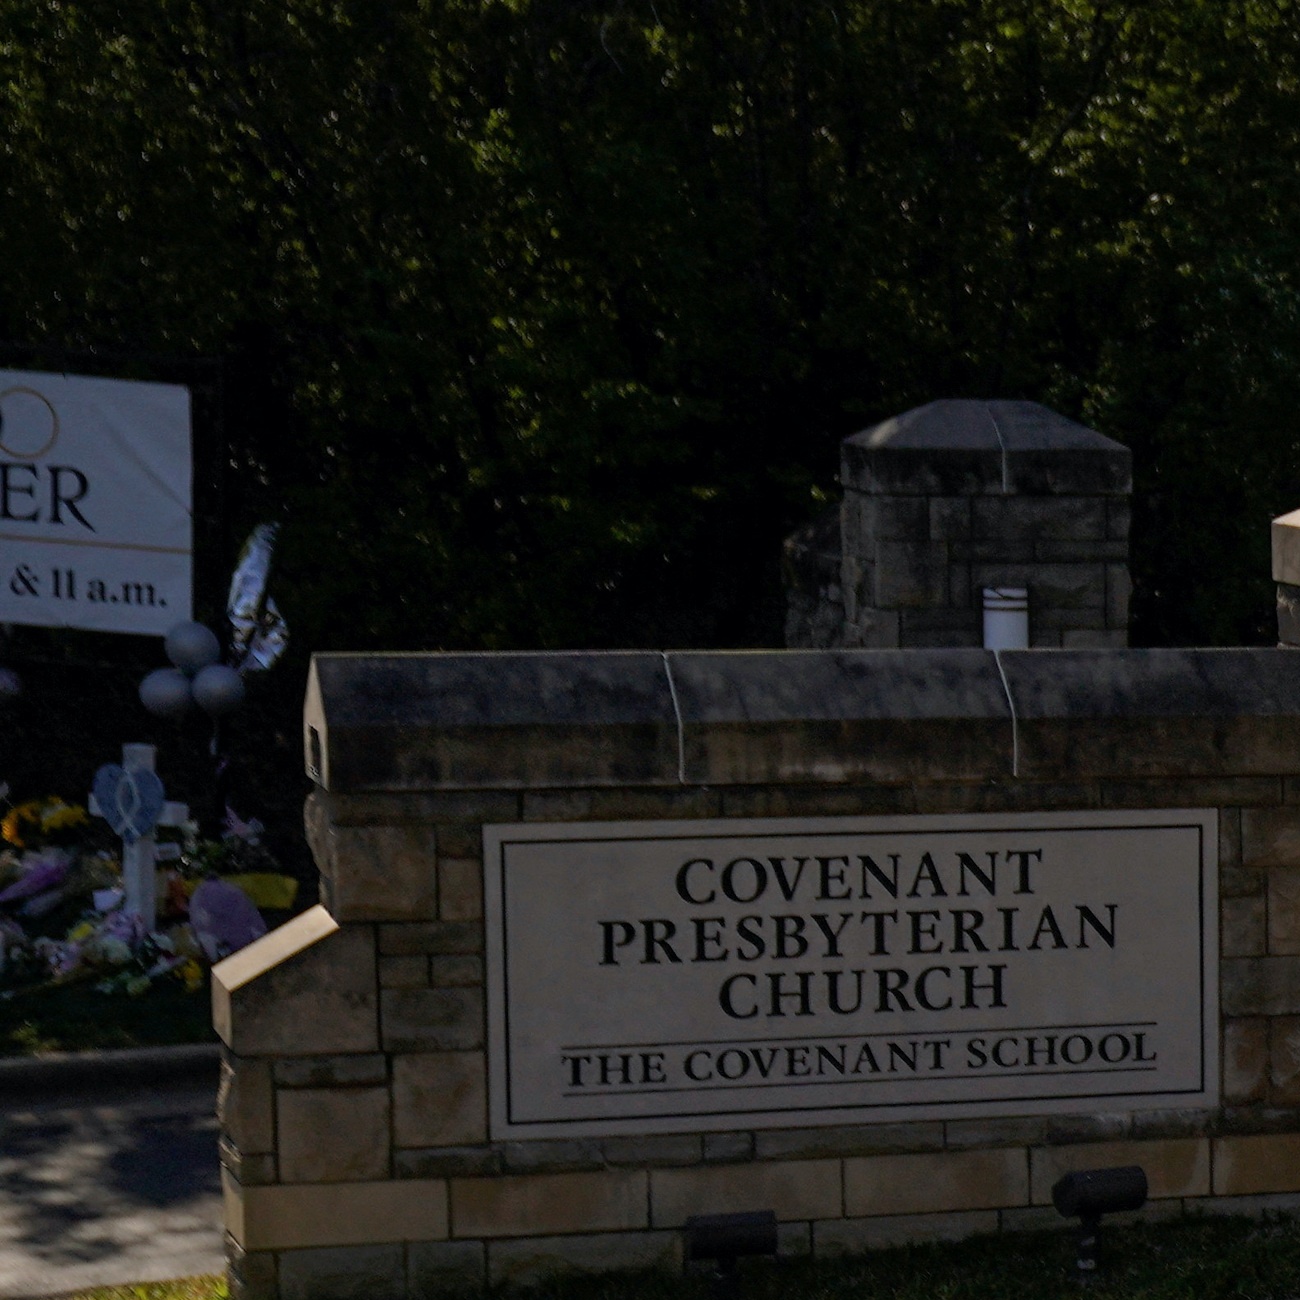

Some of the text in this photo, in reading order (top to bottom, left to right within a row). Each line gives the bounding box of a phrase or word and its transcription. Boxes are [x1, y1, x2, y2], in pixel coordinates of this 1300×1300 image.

[9, 563, 40, 598] &
[86, 579, 168, 608] a.m.
[675, 848, 1042, 905] COVENANT
[597, 903, 1119, 966] PRESBYTERIAN
[718, 963, 1008, 1020] CHURCH
[561, 1032, 1158, 1087] THE COVENANT SCHOOL
